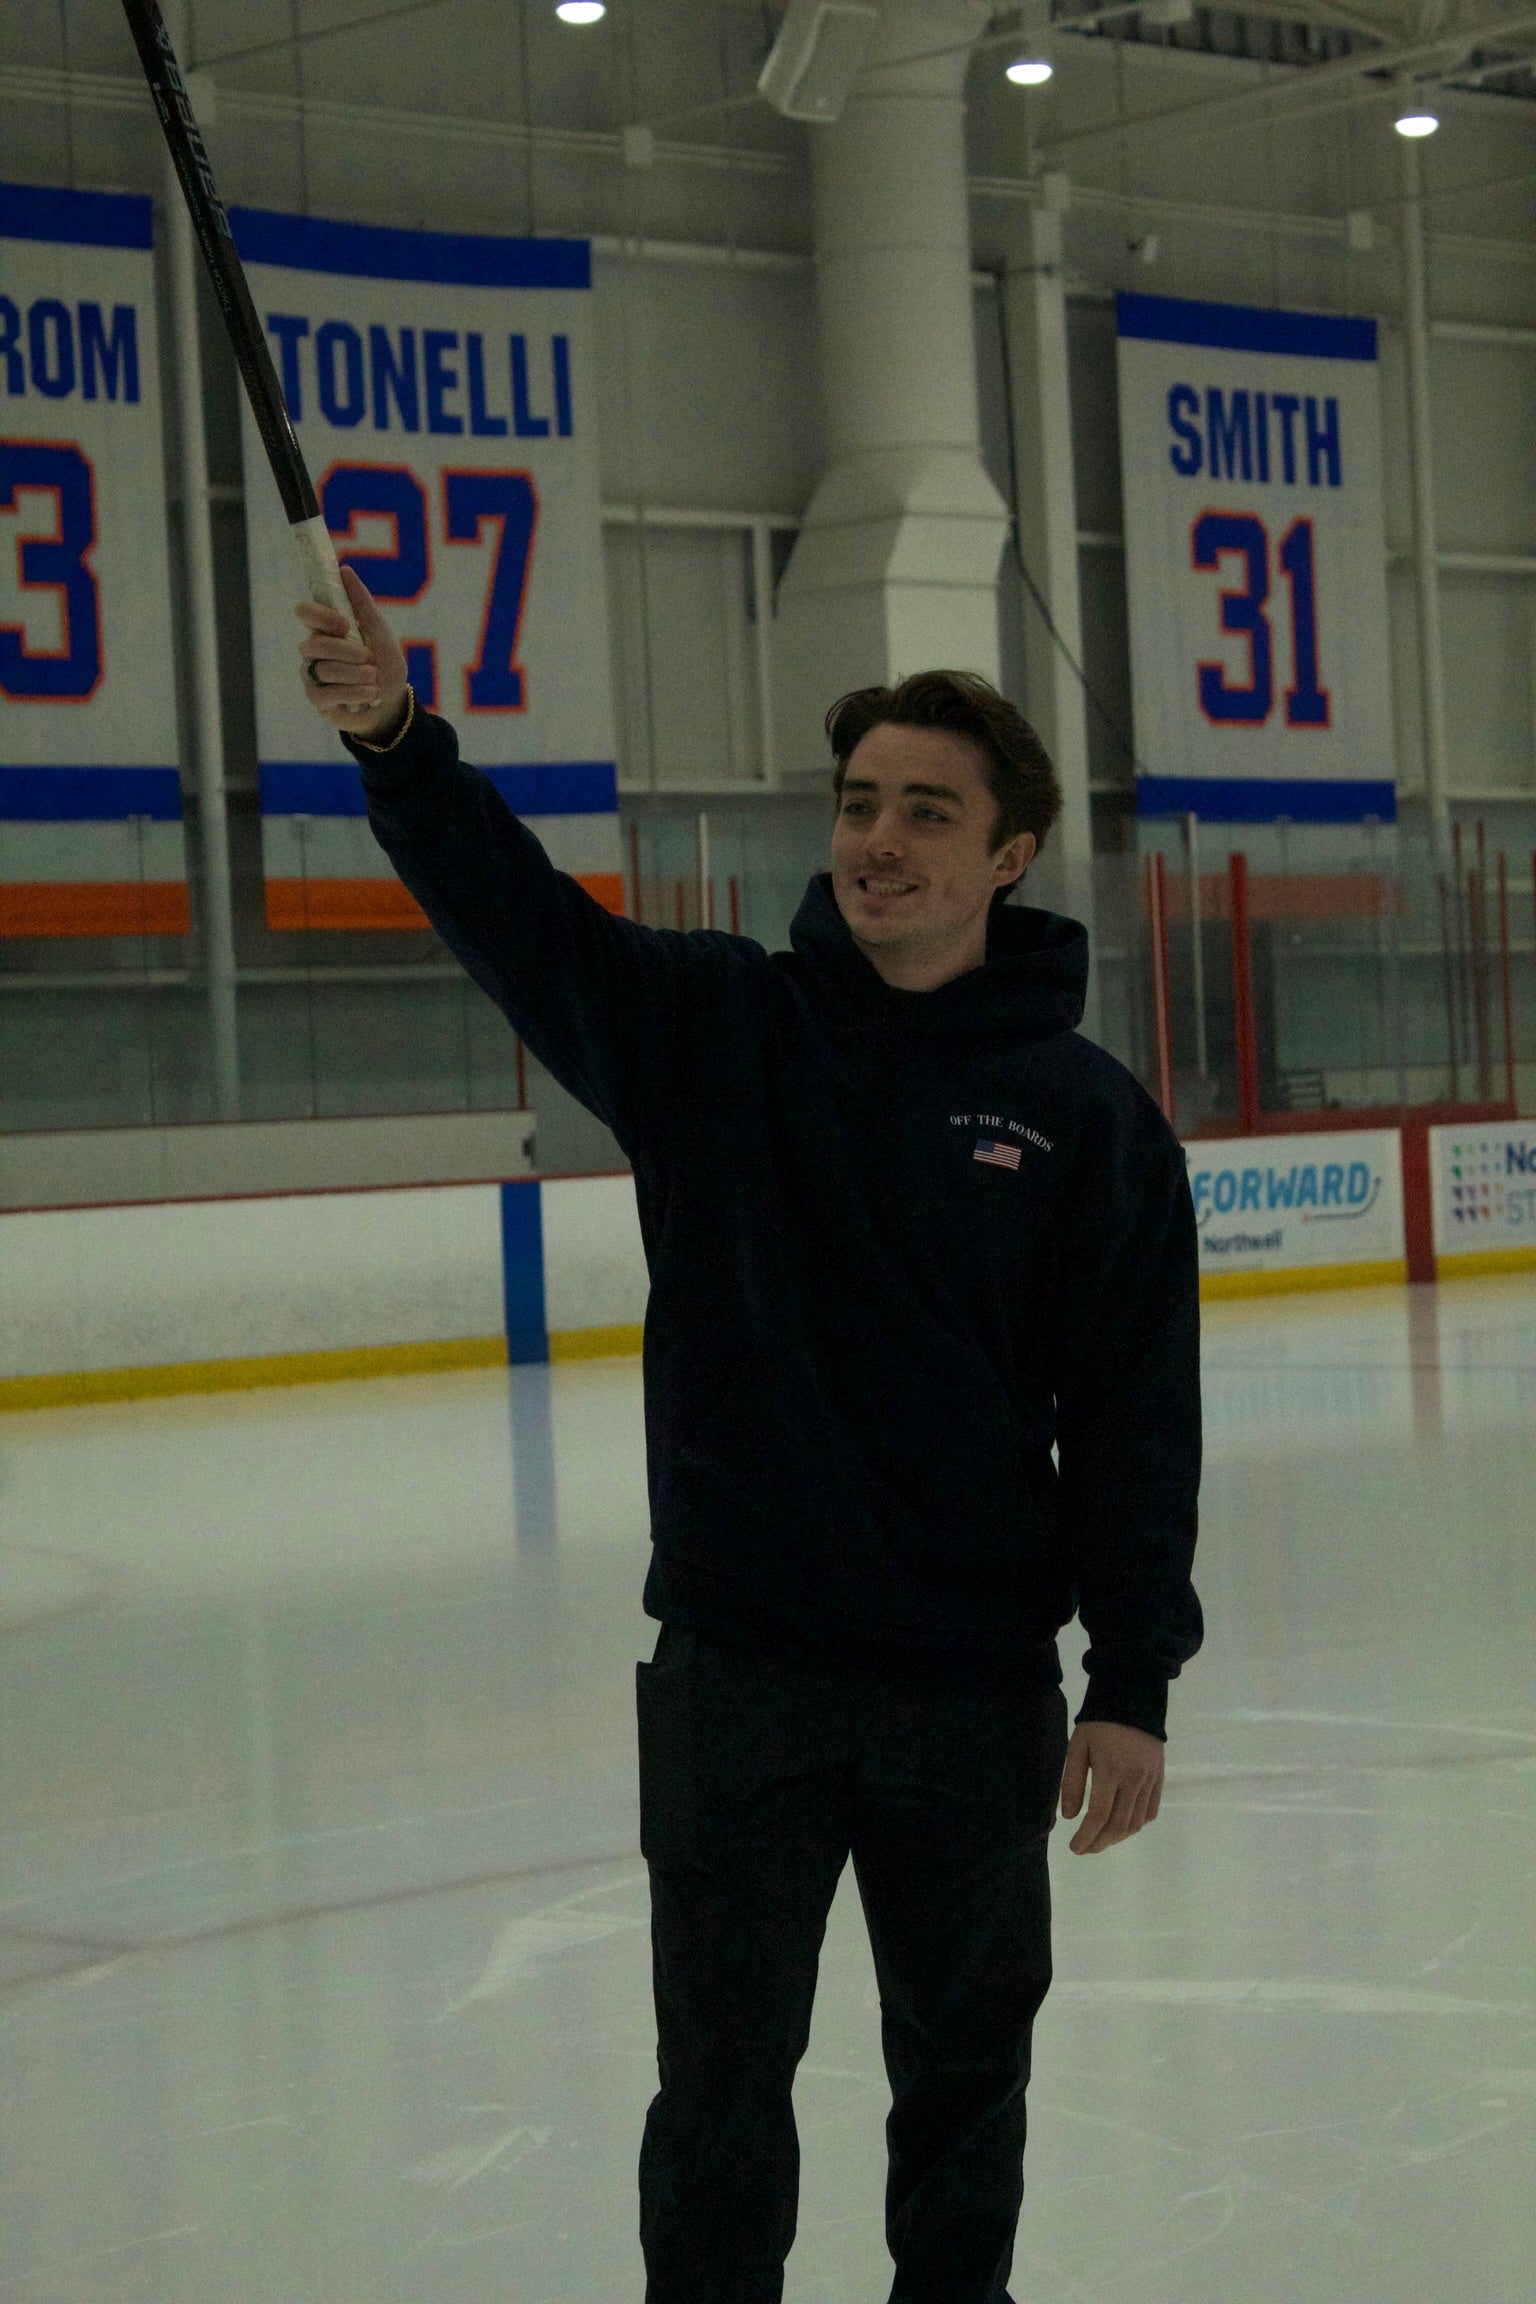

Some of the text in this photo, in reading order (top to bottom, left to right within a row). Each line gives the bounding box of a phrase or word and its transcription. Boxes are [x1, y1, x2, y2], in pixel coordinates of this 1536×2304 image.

[266, 314, 573, 437] TONELLI
[1167, 382, 1341, 487] SMITH
[317, 460, 540, 714] 27
[1191, 507, 1331, 730] 31
[949, 1114, 1055, 1153] OFF THE BOARDS
[1192, 1161, 1370, 1216] FORWARD
